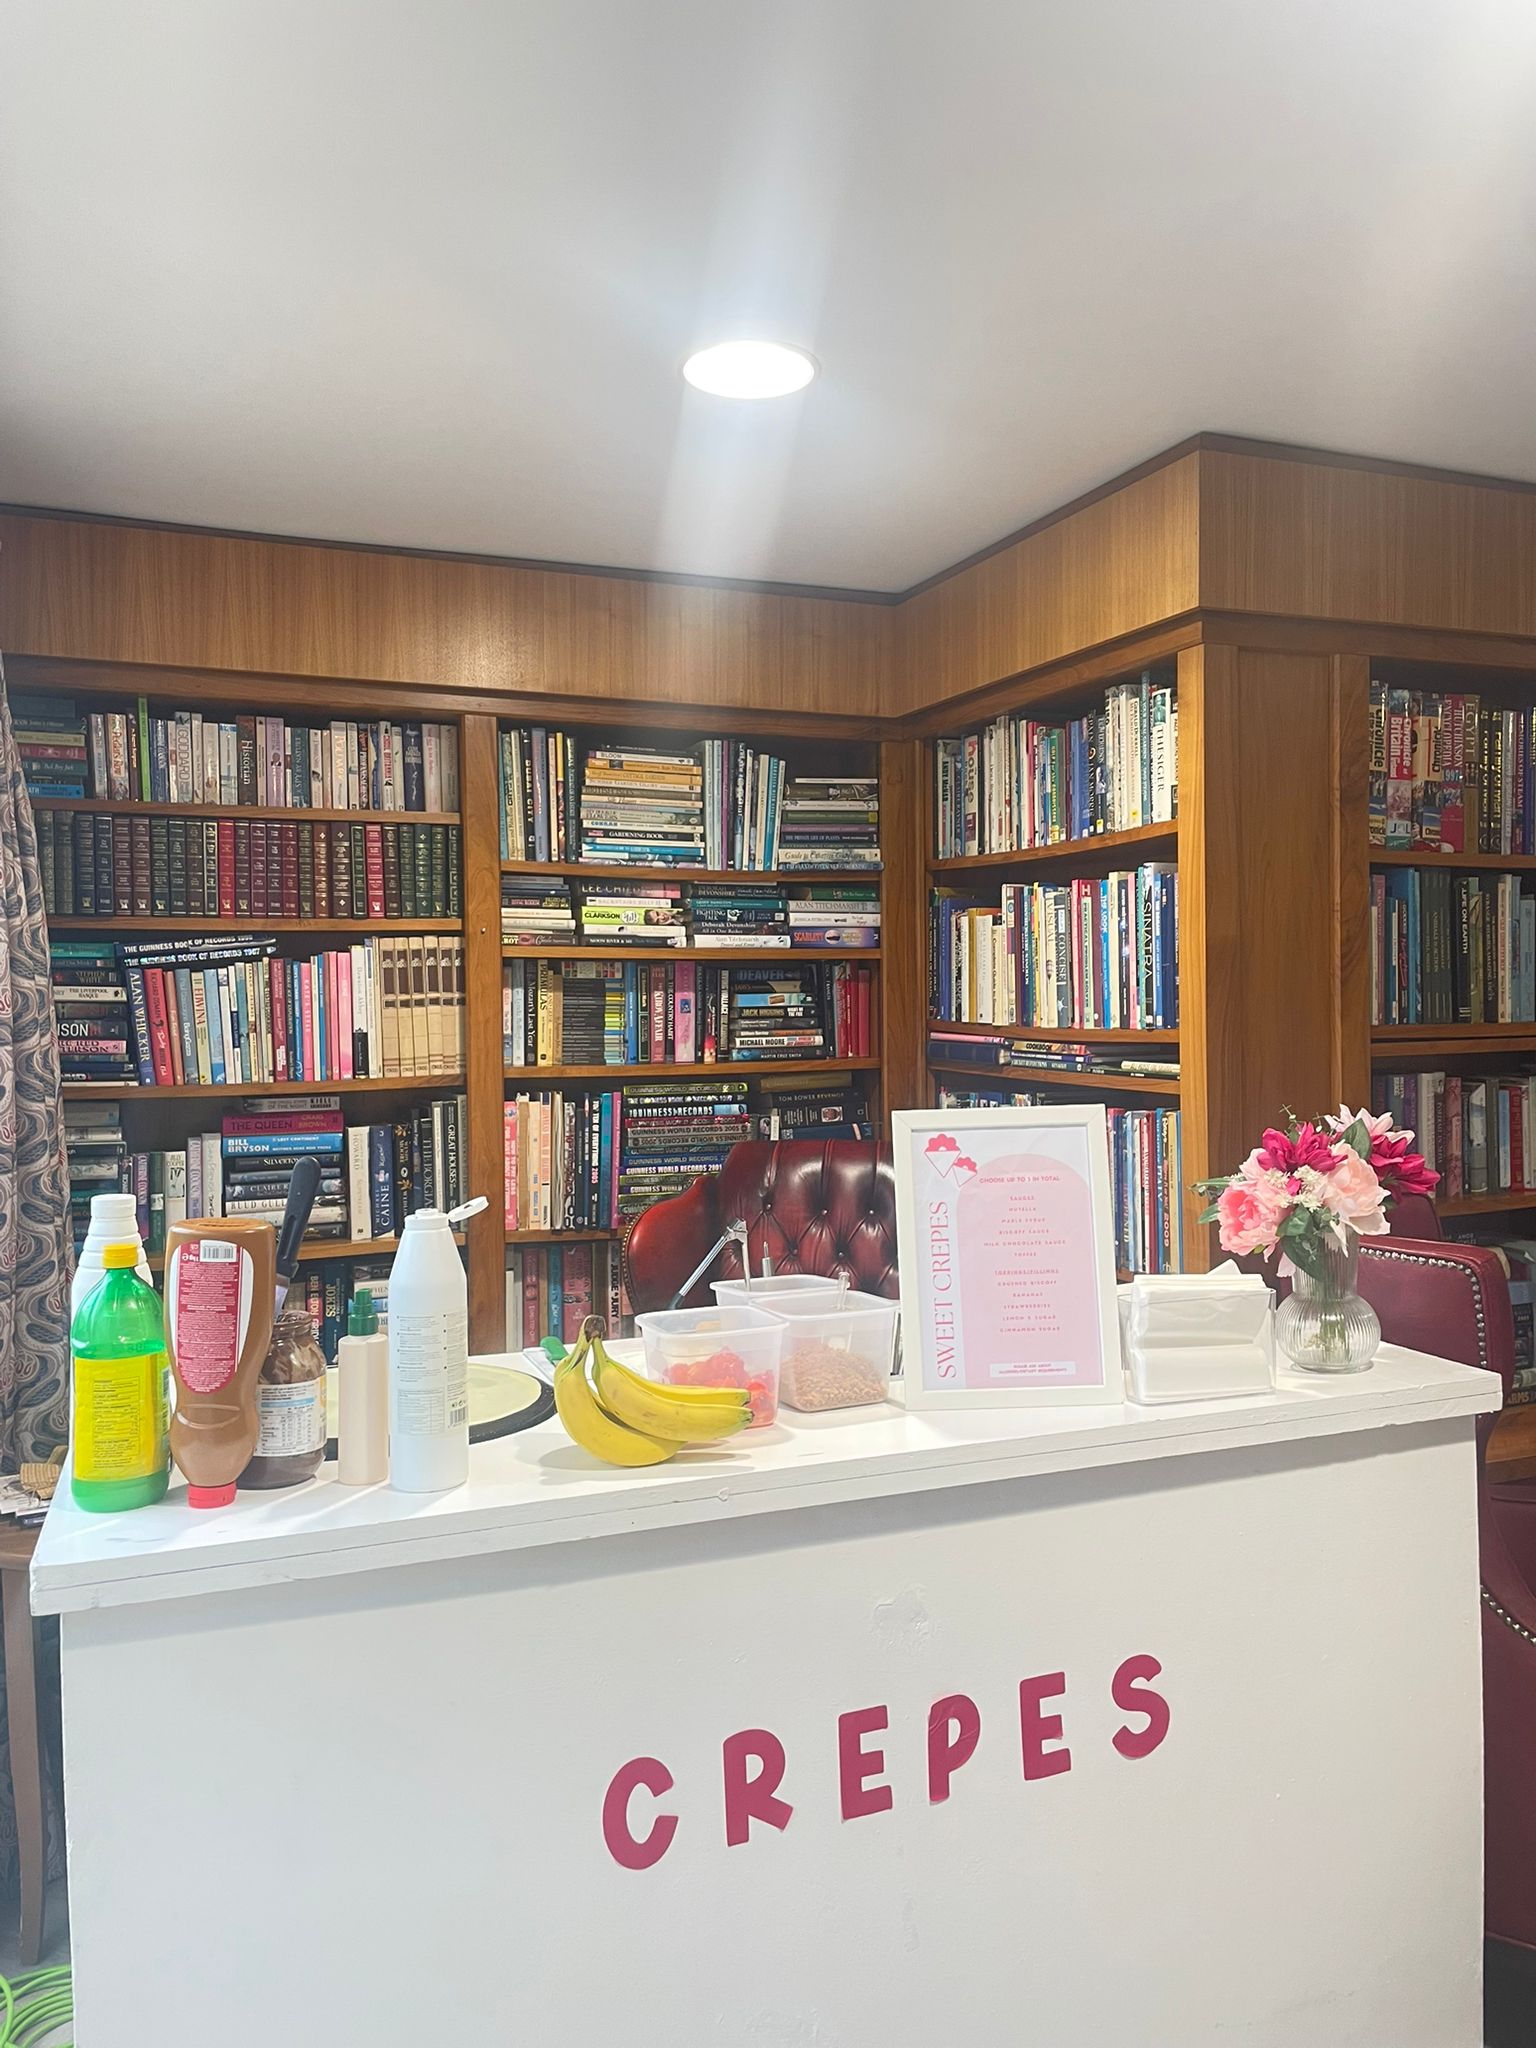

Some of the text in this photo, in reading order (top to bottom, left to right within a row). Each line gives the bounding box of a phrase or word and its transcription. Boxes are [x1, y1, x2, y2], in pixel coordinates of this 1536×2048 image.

[1390, 717, 1403, 756] Britain
[1442, 699, 1453, 767] ENCYCLOPEDIA
[1454, 709, 1464, 768] HUTCHINSON
[1465, 703, 1476, 757] EGYPT
[177, 729, 191, 780] GODDARD
[241, 740, 253, 785] Historian
[1155, 727, 1165, 793] THESIGER
[1517, 764, 1524, 775] OF
[608, 831, 645, 839] GARDENING
[583, 911, 620, 919] CLARKSON
[795, 901, 813, 909] ALAN
[1461, 908, 1468, 922] ON
[1046, 902, 1055, 945] VISUAL
[1143, 901, 1153, 980] SINATRA
[123, 945, 137, 954] THE
[138, 943, 174, 953] GUINNESS
[174, 939, 194, 949] BOOK
[1058, 934, 1067, 981] CONCISE
[539, 963, 548, 1011] PRIMULAS
[738, 969, 784, 980] DEAVER
[129, 971, 150, 1063] ALAN WHICKER
[527, 981, 536, 1047] Mozart's Last Year
[654, 1013, 664, 1042] AFFAIR
[739, 1038, 785, 1047] MICHAEL MOORE
[1025, 1042, 1053, 1051] COOKBOOK
[592, 1100, 600, 1111] TOP
[592, 1113, 600, 1123] TEN
[231, 1120, 292, 1131] THE QUEEN
[592, 1124, 600, 1132] OF
[631, 1128, 666, 1136] GUINNESS
[714, 1134, 748, 1142] GUINNESS
[227, 1145, 270, 1153] BRYSON
[447, 1124, 457, 1184] GREAT HOUSES
[592, 1132, 600, 1166] EVERYTHING
[664, 1156, 687, 1164] WORLD
[626, 1166, 656, 1175] GUINNESS
[657, 1165, 679, 1173] WORLD
[680, 1164, 707, 1172] RECORDS
[380, 1185, 390, 1227] CAINE
[630, 1185, 660, 1193] GUINNESS
[310, 1275, 319, 1316] BEN ELTON
[325, 1284, 336, 1318] JOKES
[610, 1263, 620, 1319] JUDGE JURY
[928, 1201, 957, 1379] SWEET CREPES
[602, 1653, 1171, 1870] CREPES
